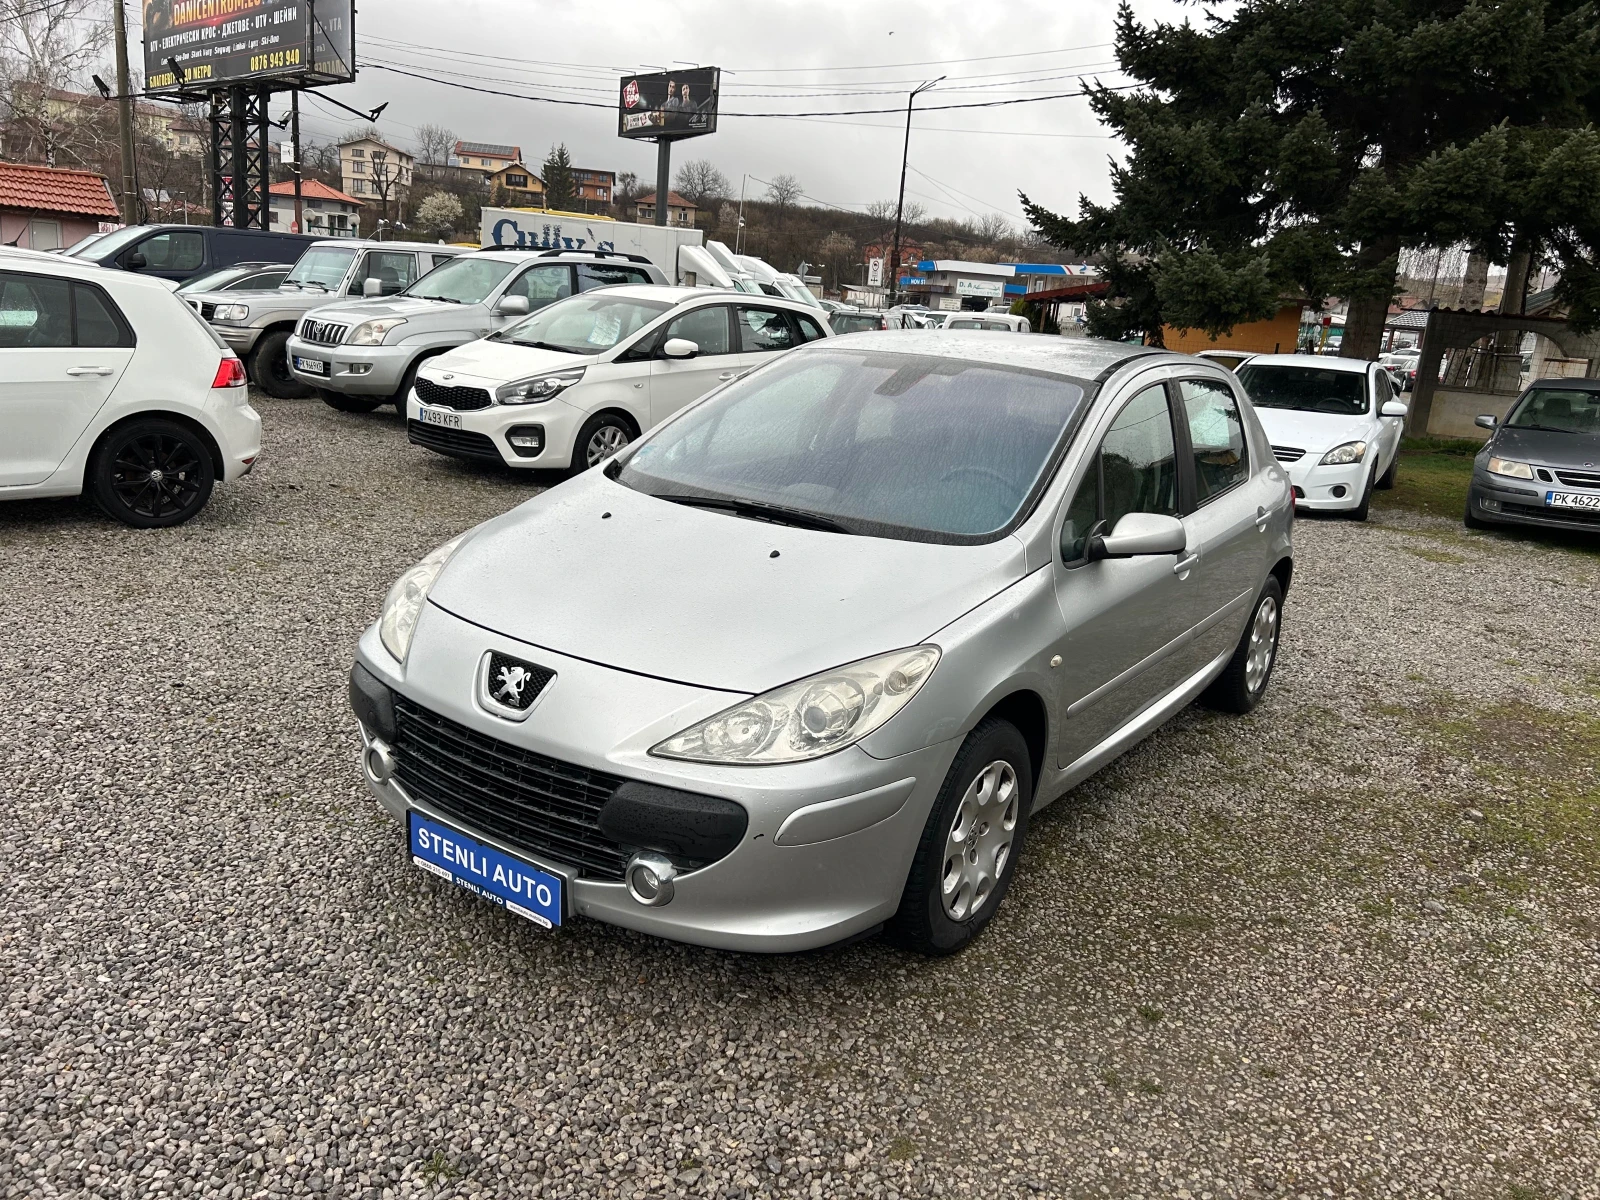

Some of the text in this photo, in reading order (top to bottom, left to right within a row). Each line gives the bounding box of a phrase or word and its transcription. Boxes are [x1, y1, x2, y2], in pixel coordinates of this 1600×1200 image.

[162, 29, 200, 49] ЕЛЕКТРИЧЕСКИ
[201, 26, 216, 40] КРОС
[221, 18, 249, 38] ДЖЕТОВЕ
[255, 14, 267, 29] UTV
[273, 6, 297, 25] ШЕЙНИ
[193, 64, 212, 79] МЕТРО
[250, 48, 300, 72] 0876 943 940
[423, 410, 460, 428] 7493 KFR
[1553, 494, 1600, 507] PK 4622
[418, 827, 552, 907] STENLI AUTO
[455, 876, 504, 905] STENLI AUTO
